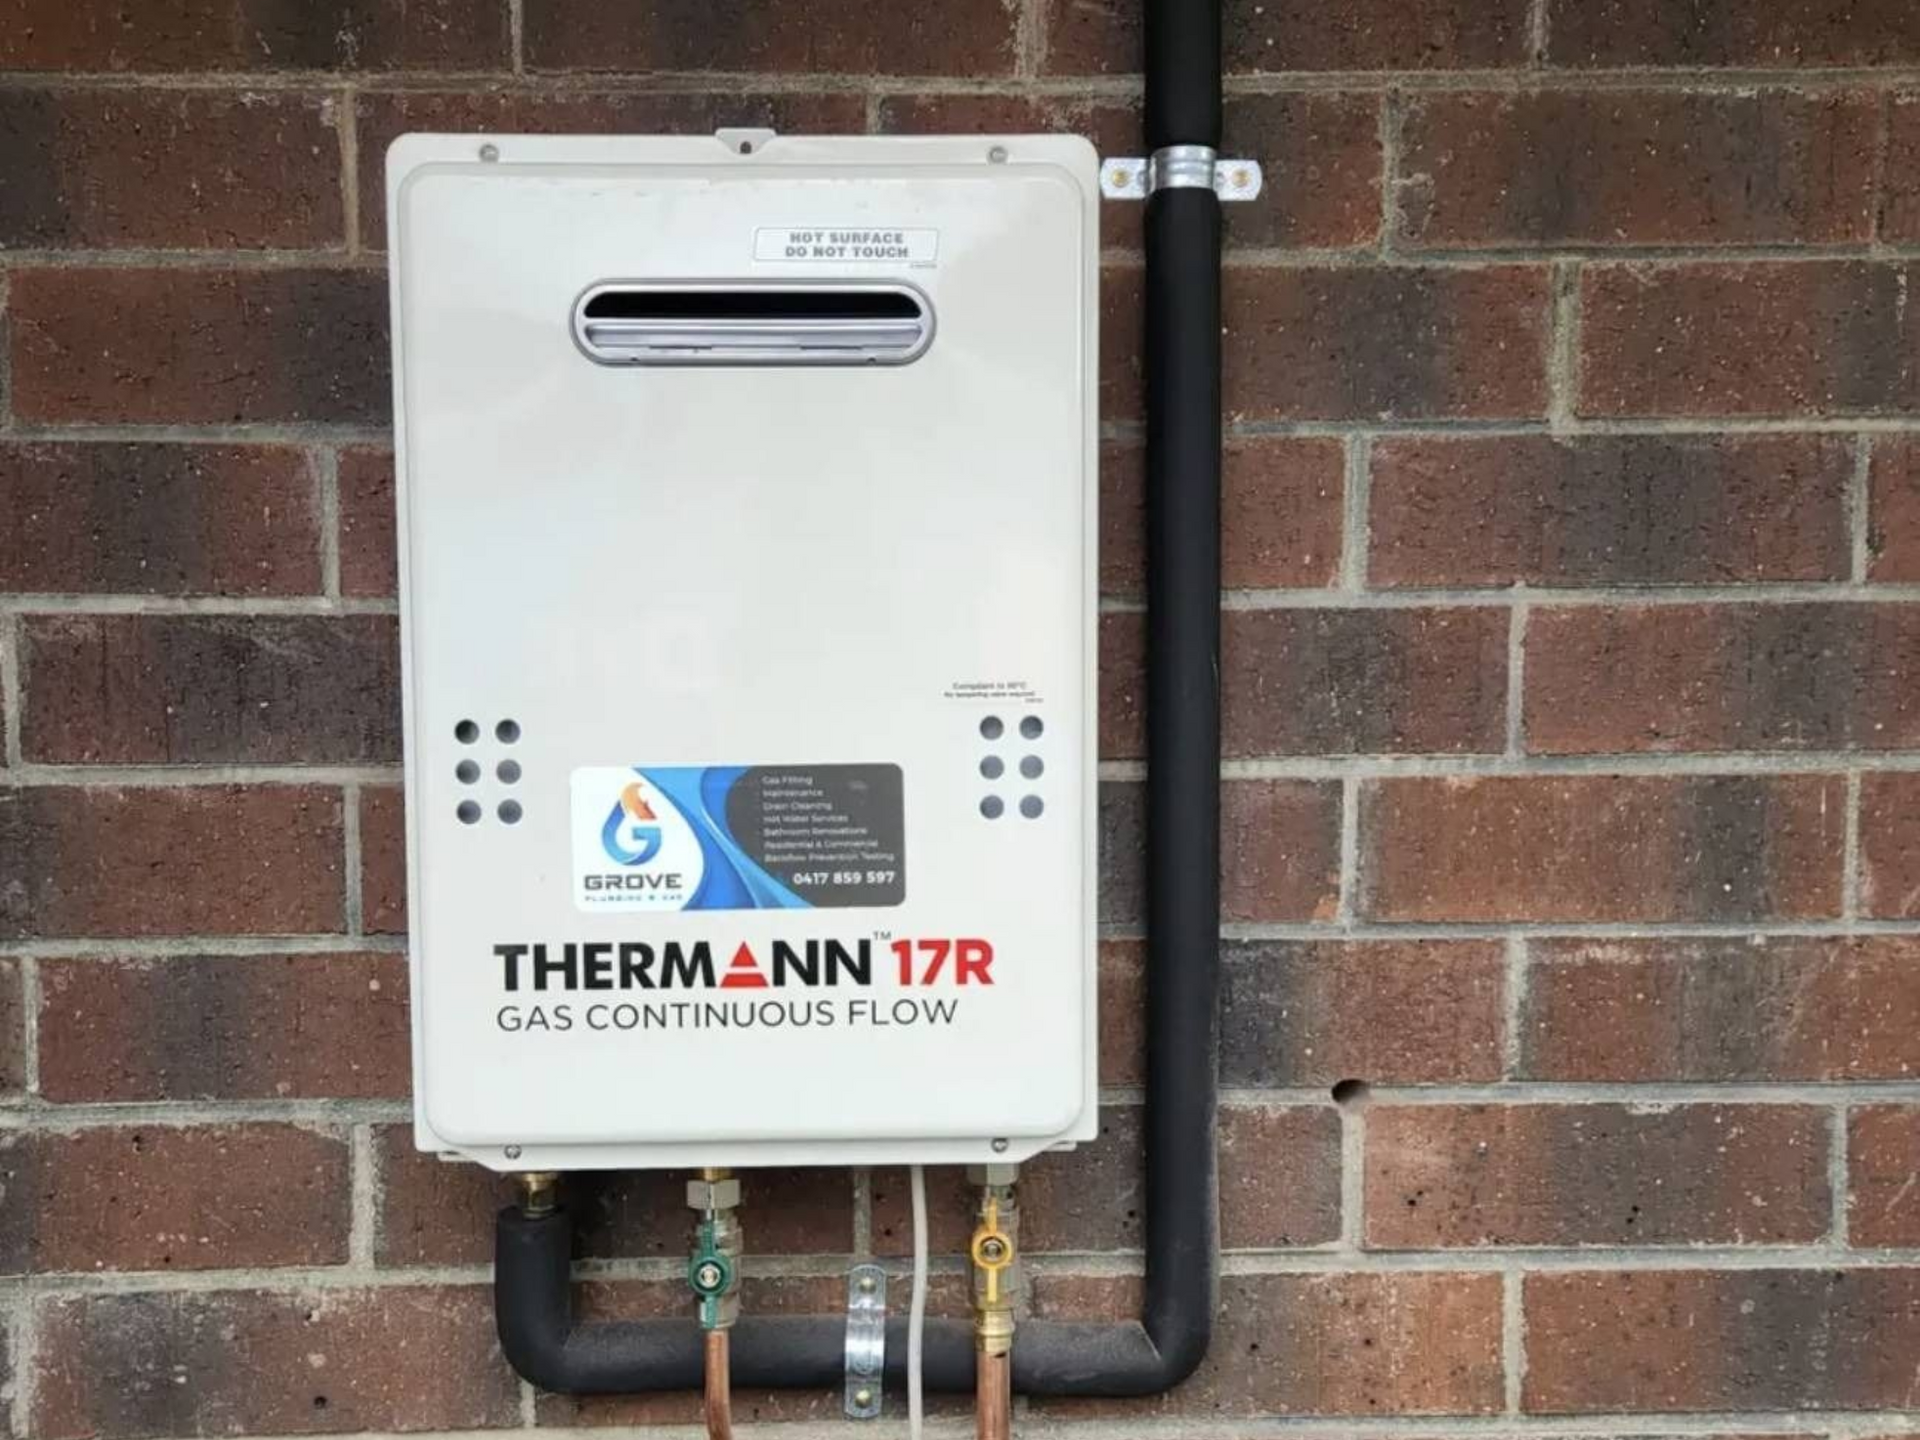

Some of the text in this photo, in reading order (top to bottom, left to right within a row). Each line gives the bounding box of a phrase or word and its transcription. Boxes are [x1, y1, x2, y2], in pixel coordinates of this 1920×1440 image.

[789, 232, 904, 244] HOT SURFACE
[785, 246, 909, 258] DO NOT TOUCH
[762, 775, 813, 786] Gas Fitting
[790, 801, 833, 812] Cleaning
[811, 813, 849, 823] Services
[860, 851, 895, 862] Testing
[584, 873, 683, 891] GROVE
[793, 870, 896, 885] 0417 859 597
[493, 938, 871, 992] THERMANN
[890, 938, 995, 986] 17R
[496, 998, 959, 1032] GAS CONTINUOUS FLOW
